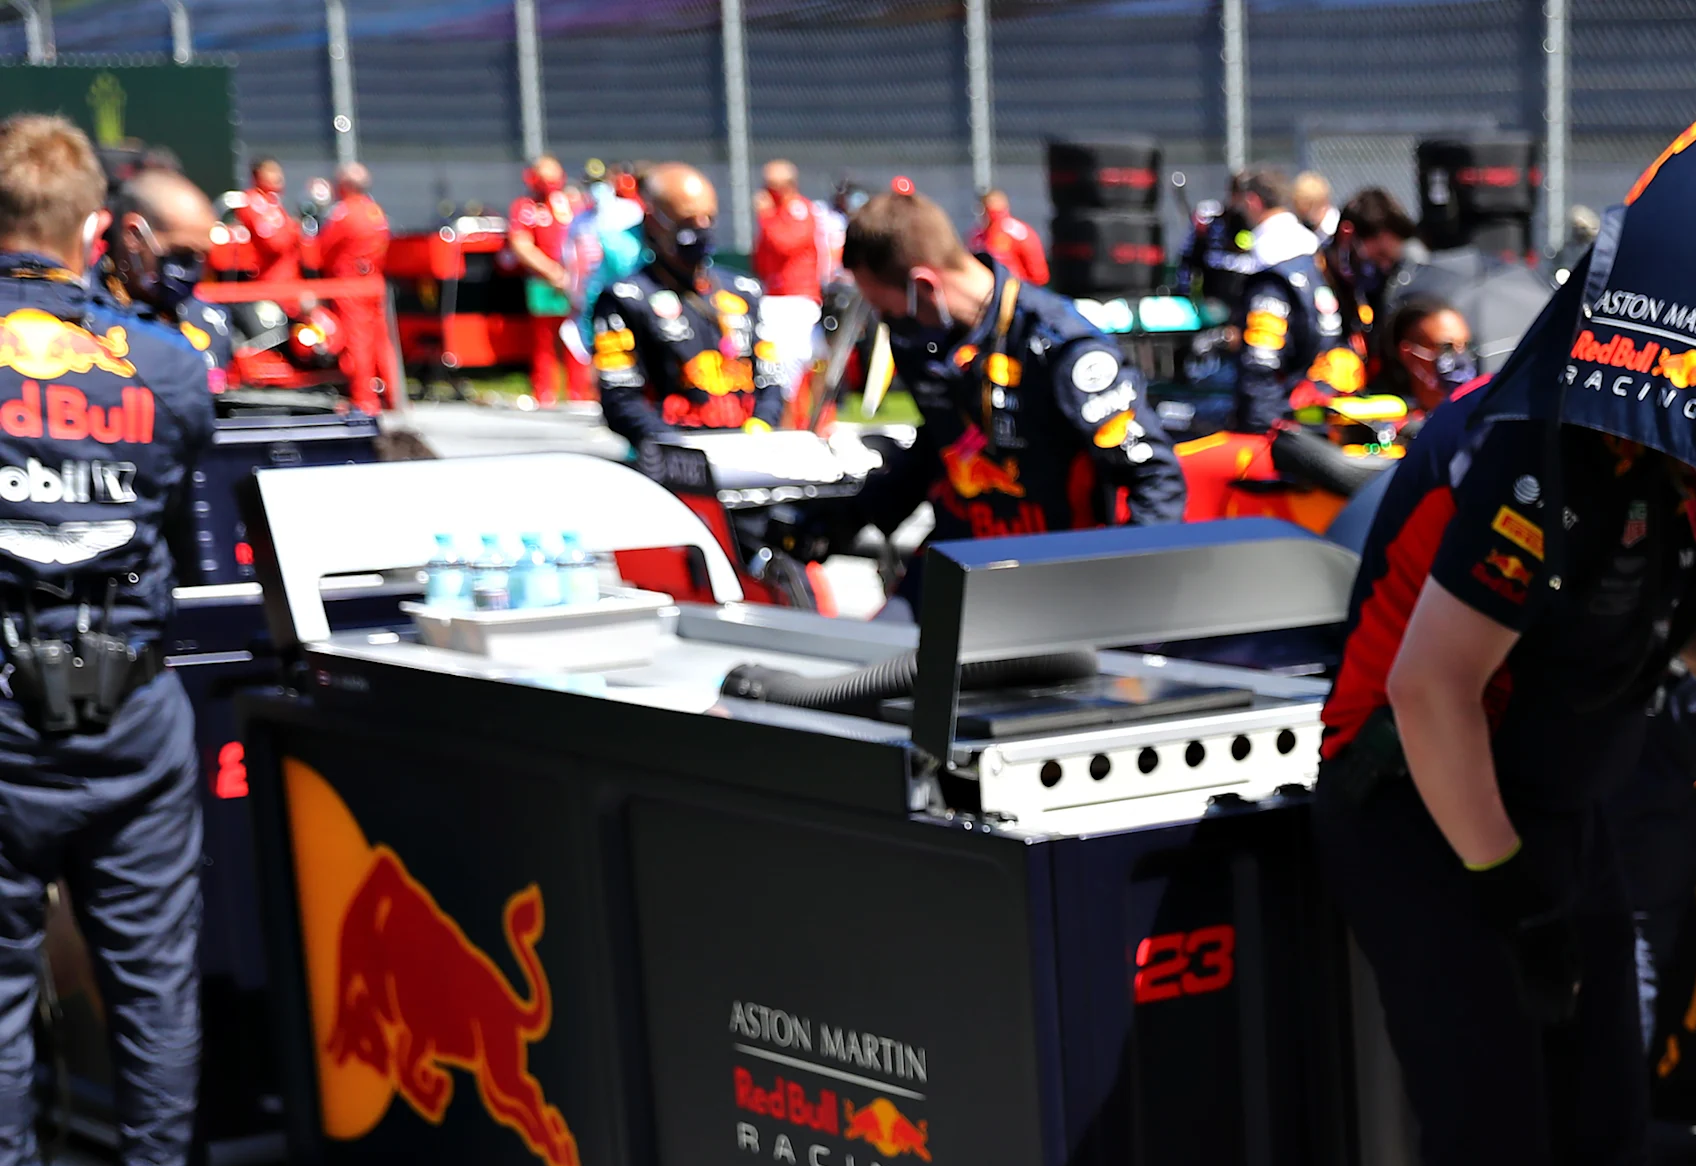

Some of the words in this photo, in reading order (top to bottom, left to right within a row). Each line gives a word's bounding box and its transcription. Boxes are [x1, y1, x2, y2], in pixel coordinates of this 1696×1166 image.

[1593, 288, 1664, 323] ASTON
[1570, 329, 1621, 365] Red
[1611, 335, 1661, 374] Bull
[45, 383, 156, 445] Bull
[1133, 923, 1237, 1006] 23
[728, 999, 813, 1052] ASTON
[819, 1021, 928, 1084] MARTIN
[733, 1064, 787, 1121] Red
[786, 1079, 840, 1137] Bull
